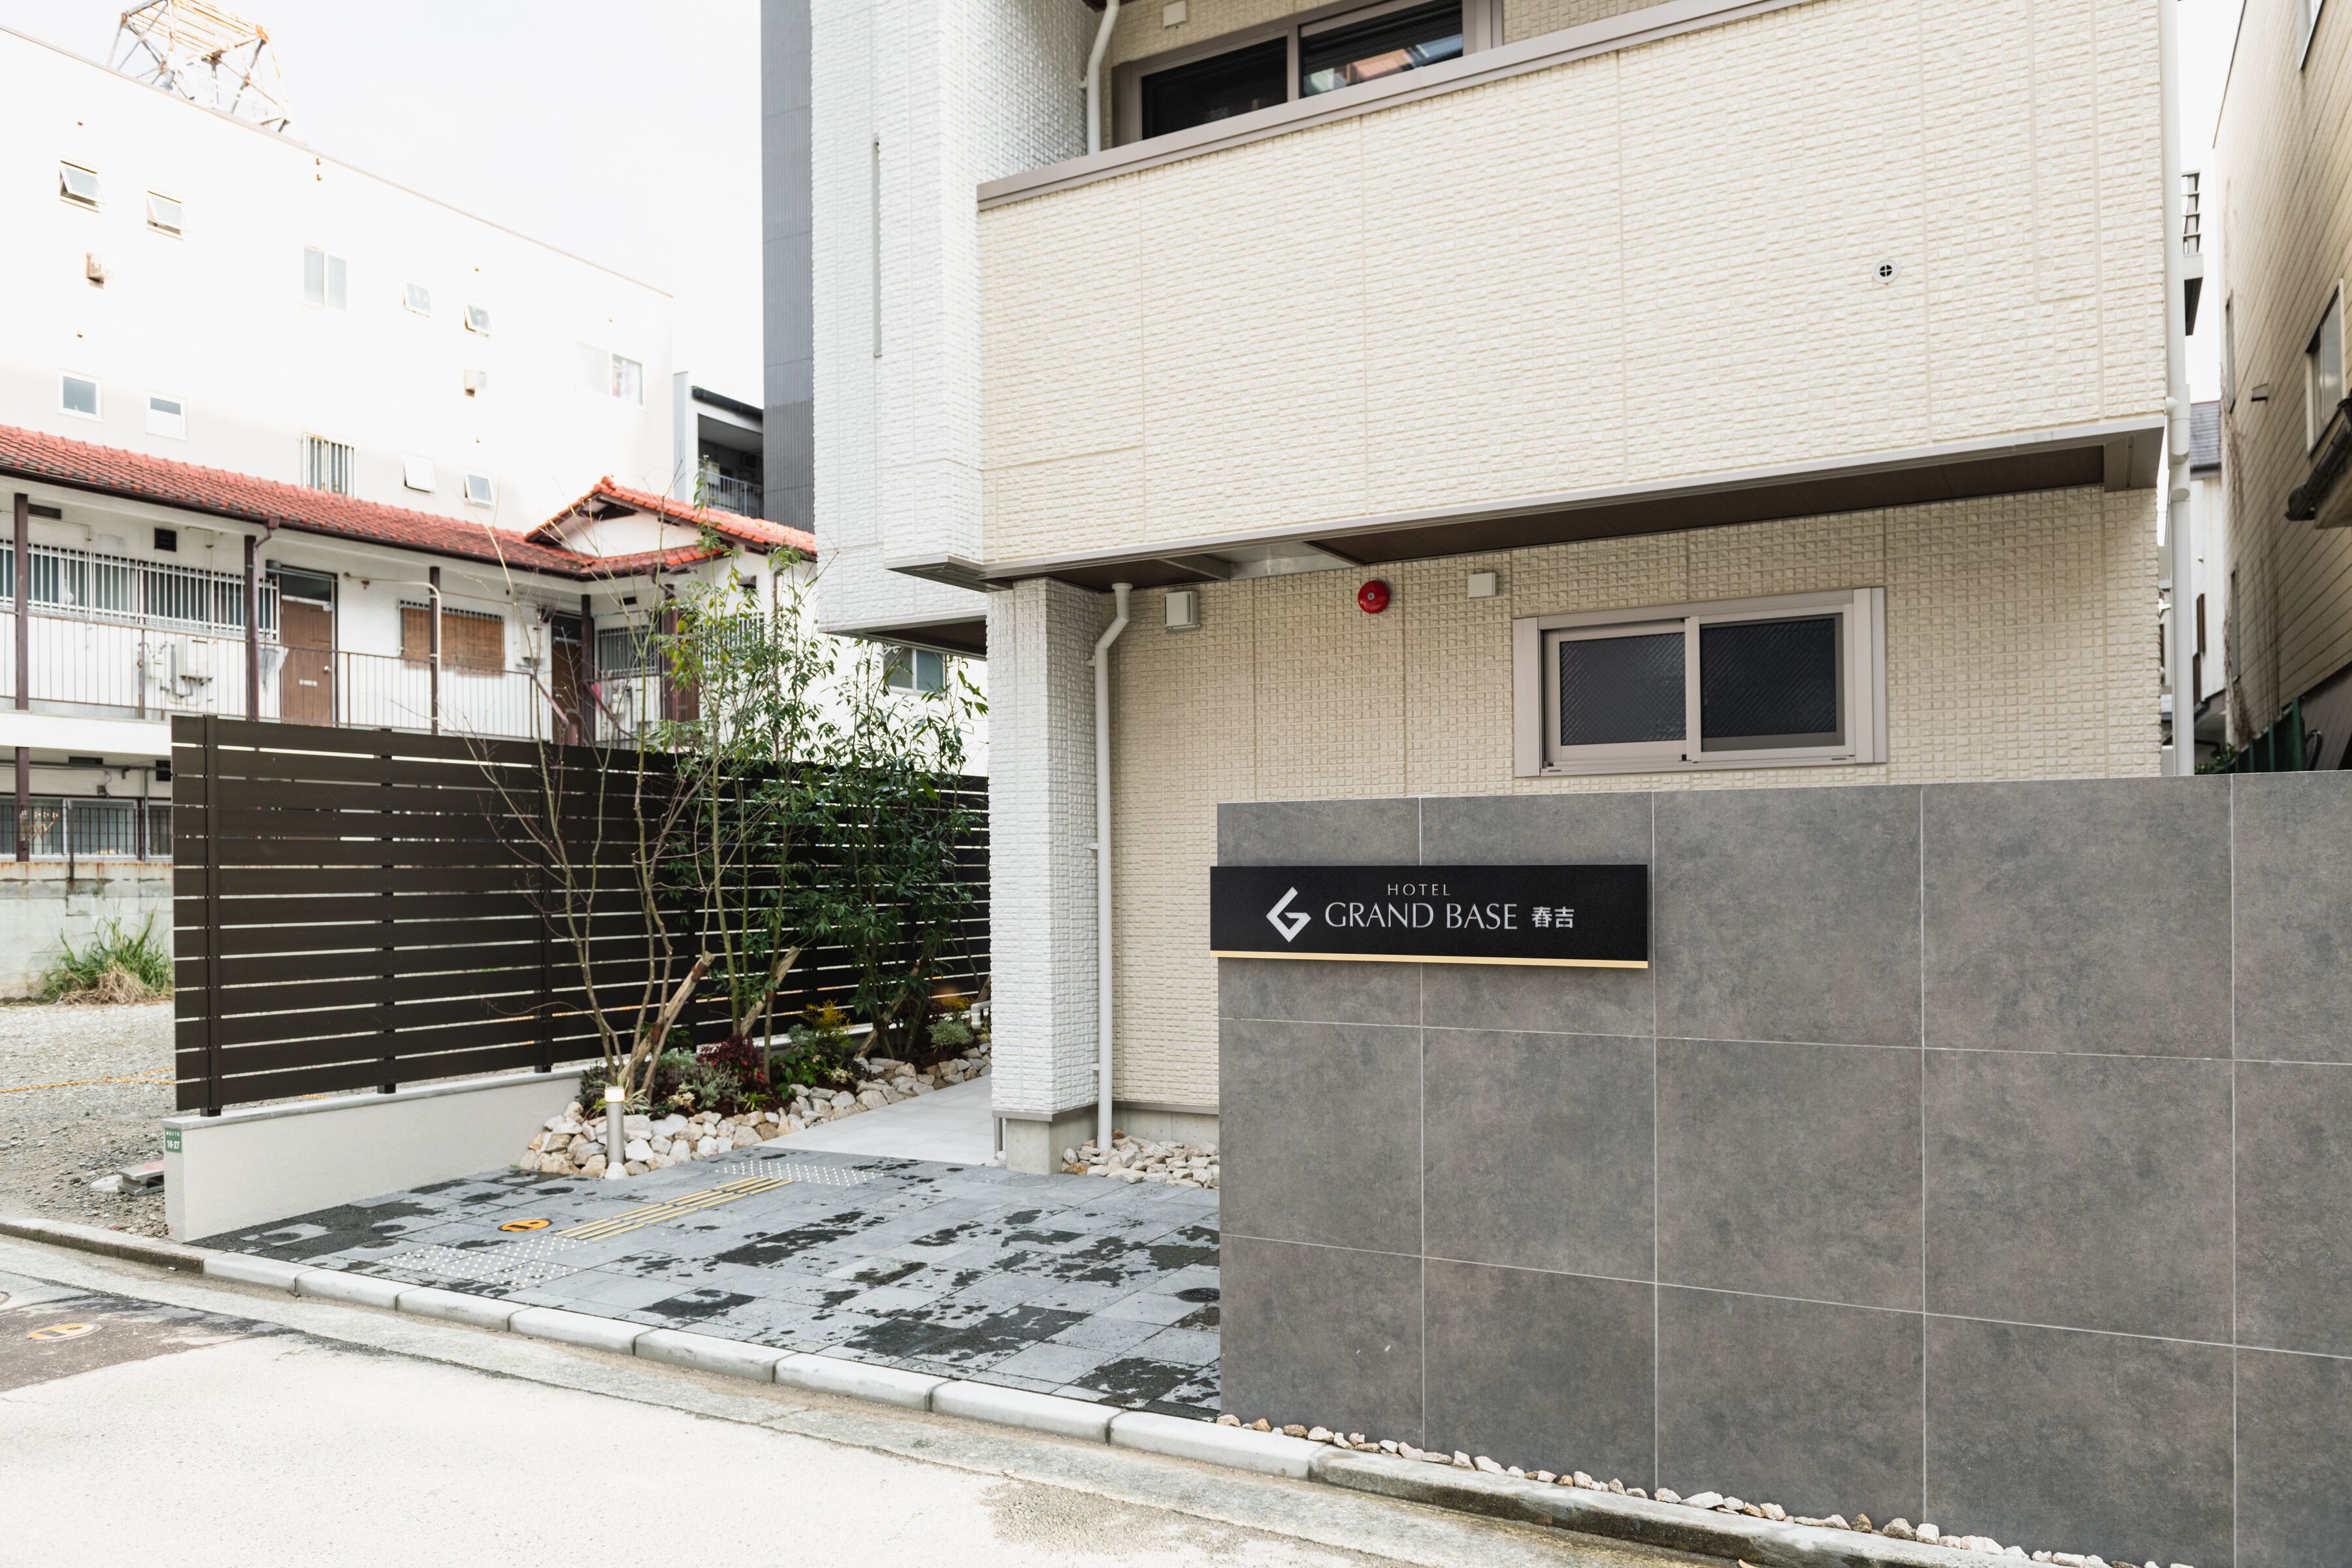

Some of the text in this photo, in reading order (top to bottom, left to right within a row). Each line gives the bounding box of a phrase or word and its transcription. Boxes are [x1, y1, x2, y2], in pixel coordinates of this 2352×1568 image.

[1388, 883, 1450, 896] HOTEL
[1325, 902, 1575, 929] GRAND BASE 春吉
[167, 1140, 180, 1149] 16-27
